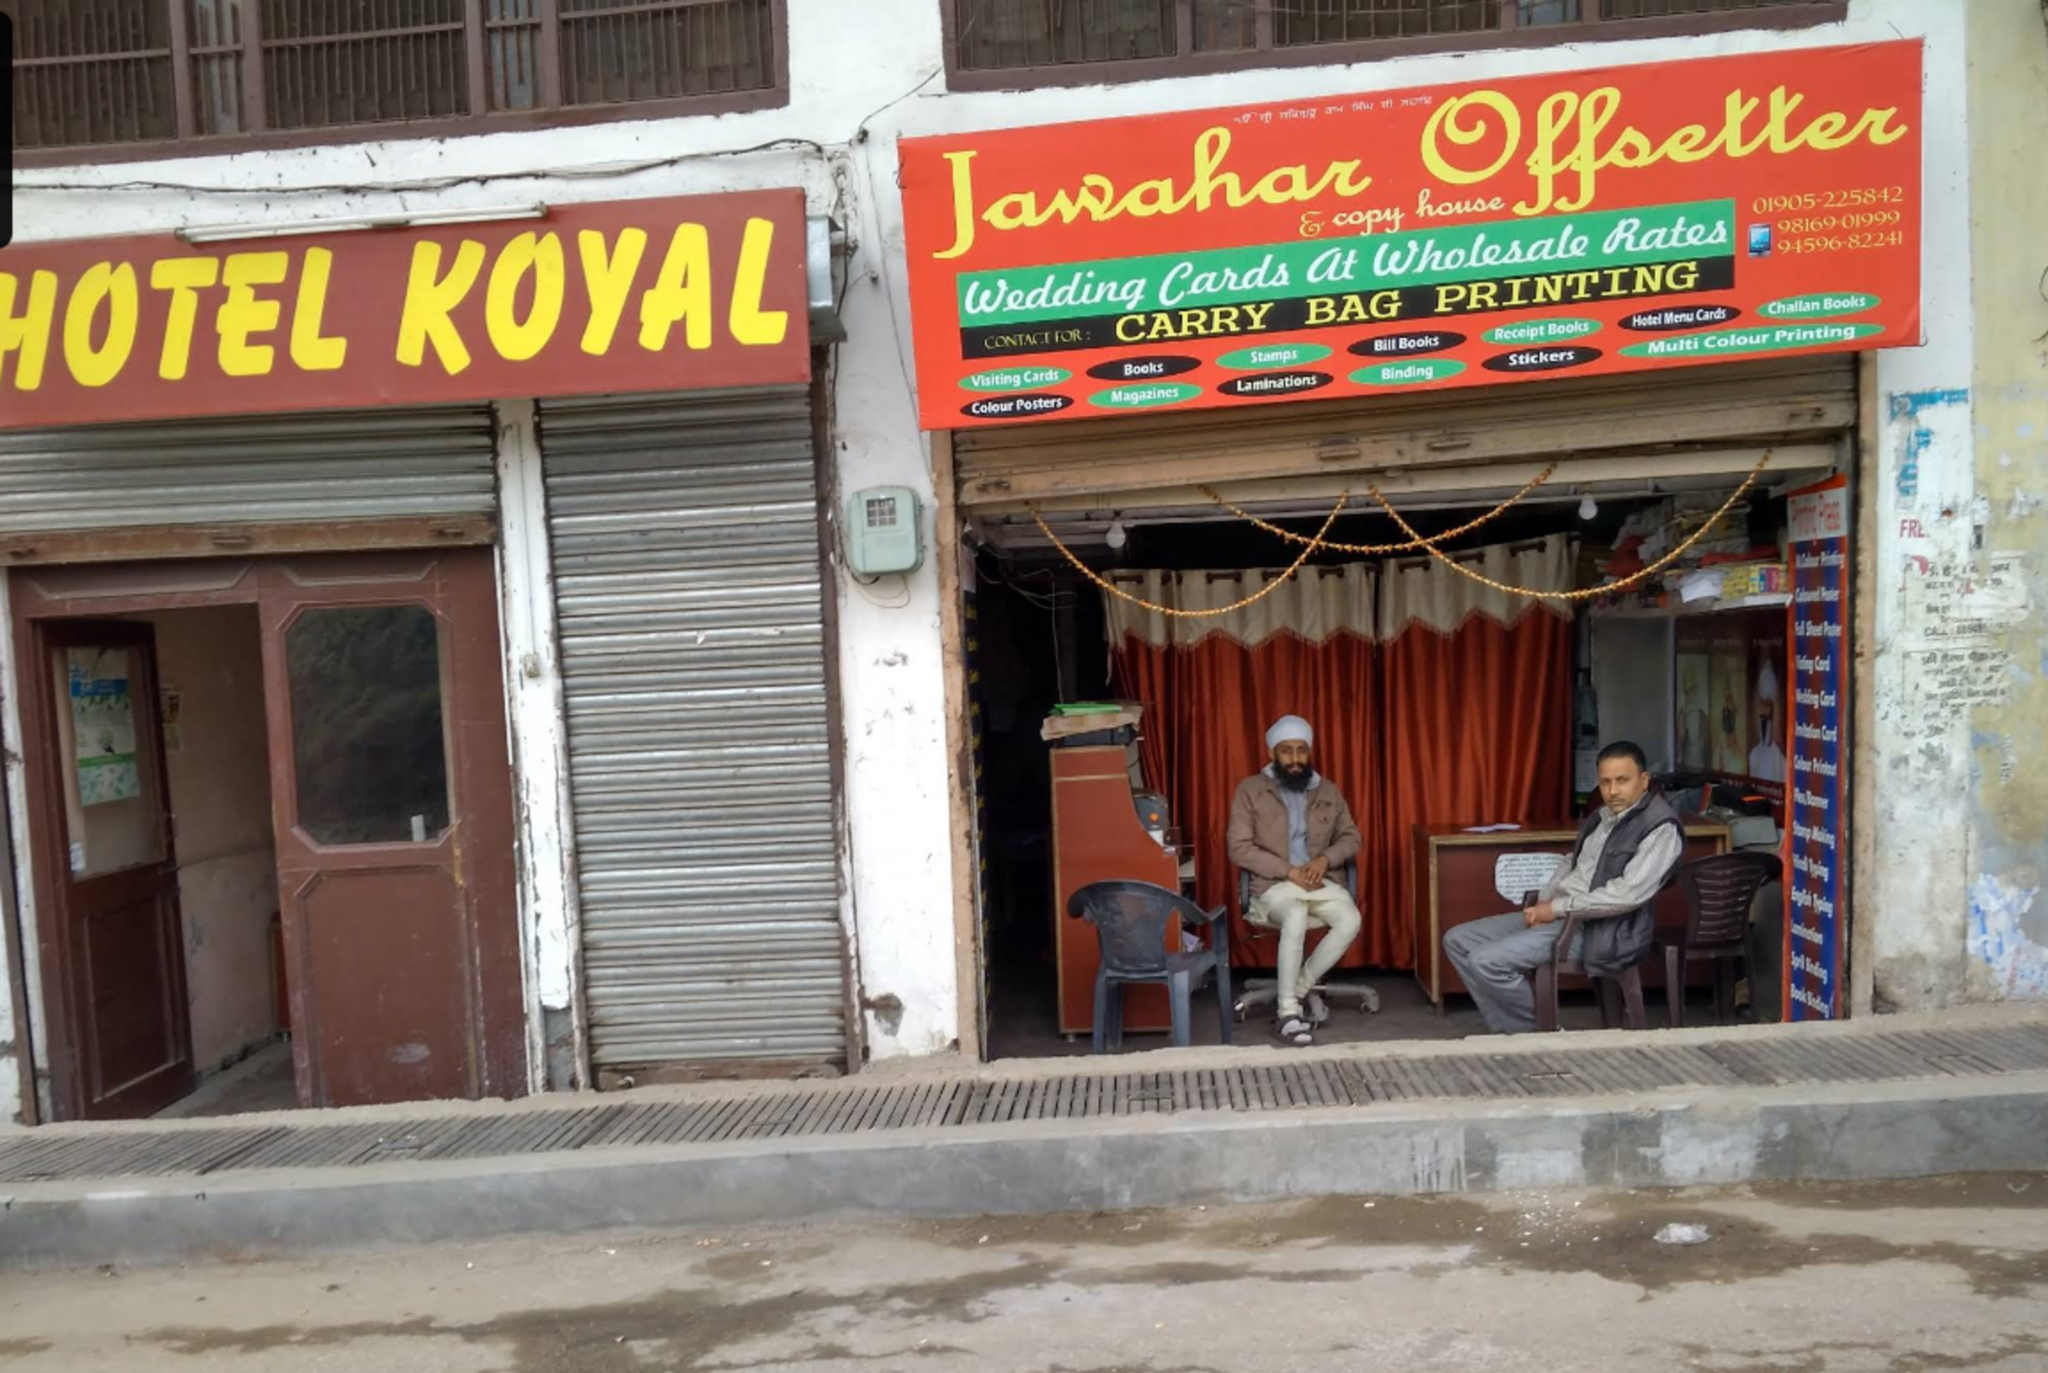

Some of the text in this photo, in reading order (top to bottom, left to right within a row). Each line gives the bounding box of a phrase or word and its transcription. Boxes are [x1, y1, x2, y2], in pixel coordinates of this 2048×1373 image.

[932, 85, 1908, 259] Jawahar Offsetter
[1753, 186, 1903, 214] 01905-225842
[1299, 188, 1504, 237] & copy house
[1777, 210, 1900, 234] 98169-01999
[1777, 231, 1902, 254] 94596-82241
[965, 216, 1728, 314] Wedding Cards At Wholesale Rates
[0, 217, 788, 391] HOTEL KOYAL
[1115, 261, 1700, 342] CARRY BAG PRINTING
[1768, 295, 1866, 315] Challan Books
[1632, 307, 1727, 327] Hotel Menu Cards
[984, 330, 1050, 350] CONTACT
[1054, 328, 1083, 343] FOR
[1494, 321, 1590, 341] Receipt Books
[1647, 325, 1855, 354] Multi Colour Printing
[1374, 335, 1440, 351] Bill Books
[1251, 348, 1298, 363] Stamps
[1508, 350, 1575, 366] Stickers
[971, 368, 1059, 388] Visiting Cards
[1123, 361, 1164, 376] Books
[1381, 364, 1434, 380] Binding
[1237, 373, 1317, 392] Laminations
[1110, 386, 1179, 404] Magazines
[971, 396, 1063, 415] Colour Posters
